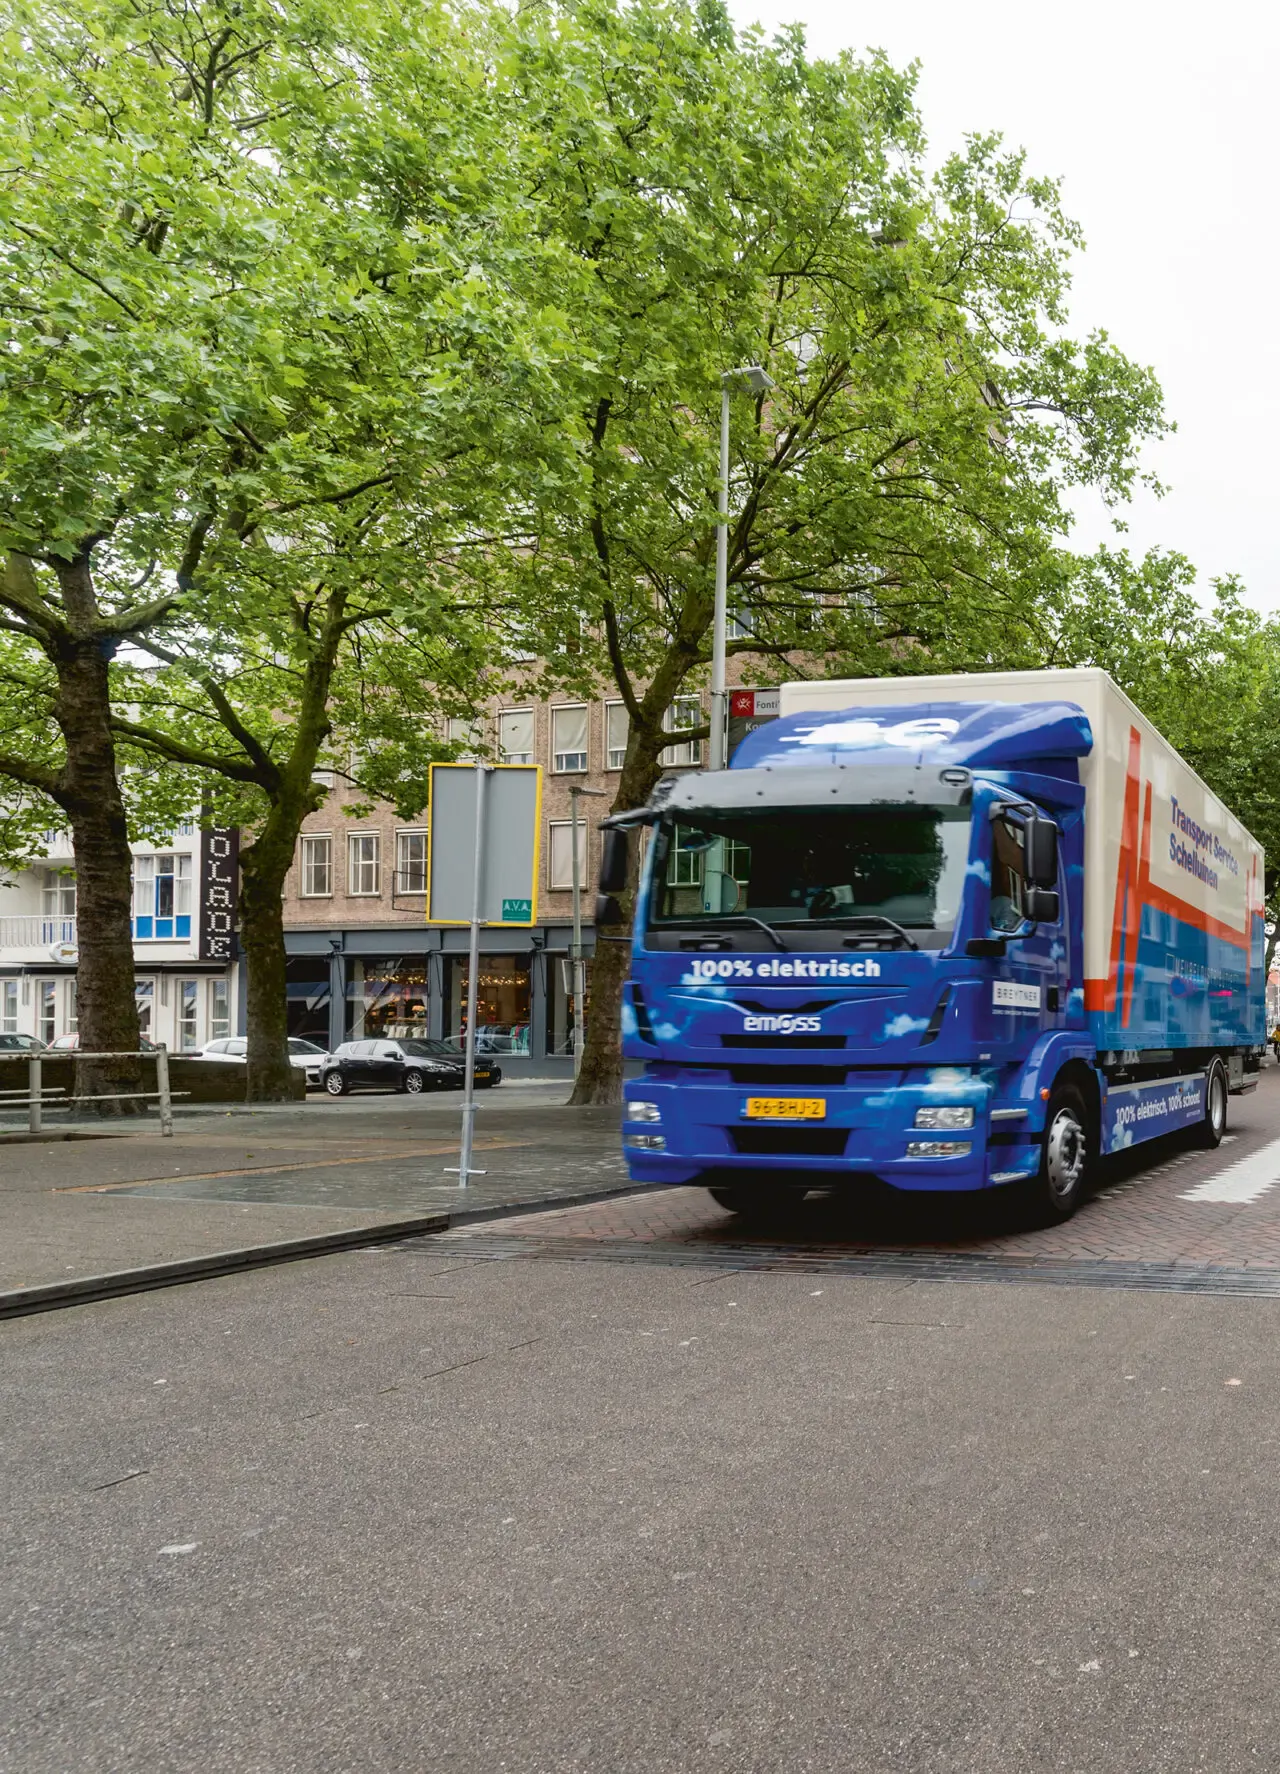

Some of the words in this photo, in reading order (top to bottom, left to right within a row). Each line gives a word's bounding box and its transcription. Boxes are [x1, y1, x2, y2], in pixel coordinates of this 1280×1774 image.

[1170, 794, 1213, 855] Transport
[1213, 835, 1239, 876] Service
[1169, 832, 1218, 892] Schelluinen
[691, 959, 754, 978] 100%
[756, 959, 881, 978] elektrisch
[997, 987, 1037, 1002] BREYTNER
[1116, 1104, 1136, 1125] 100%
[1137, 1097, 1168, 1116] elektrisch,
[1168, 1093, 1183, 1112] 100%
